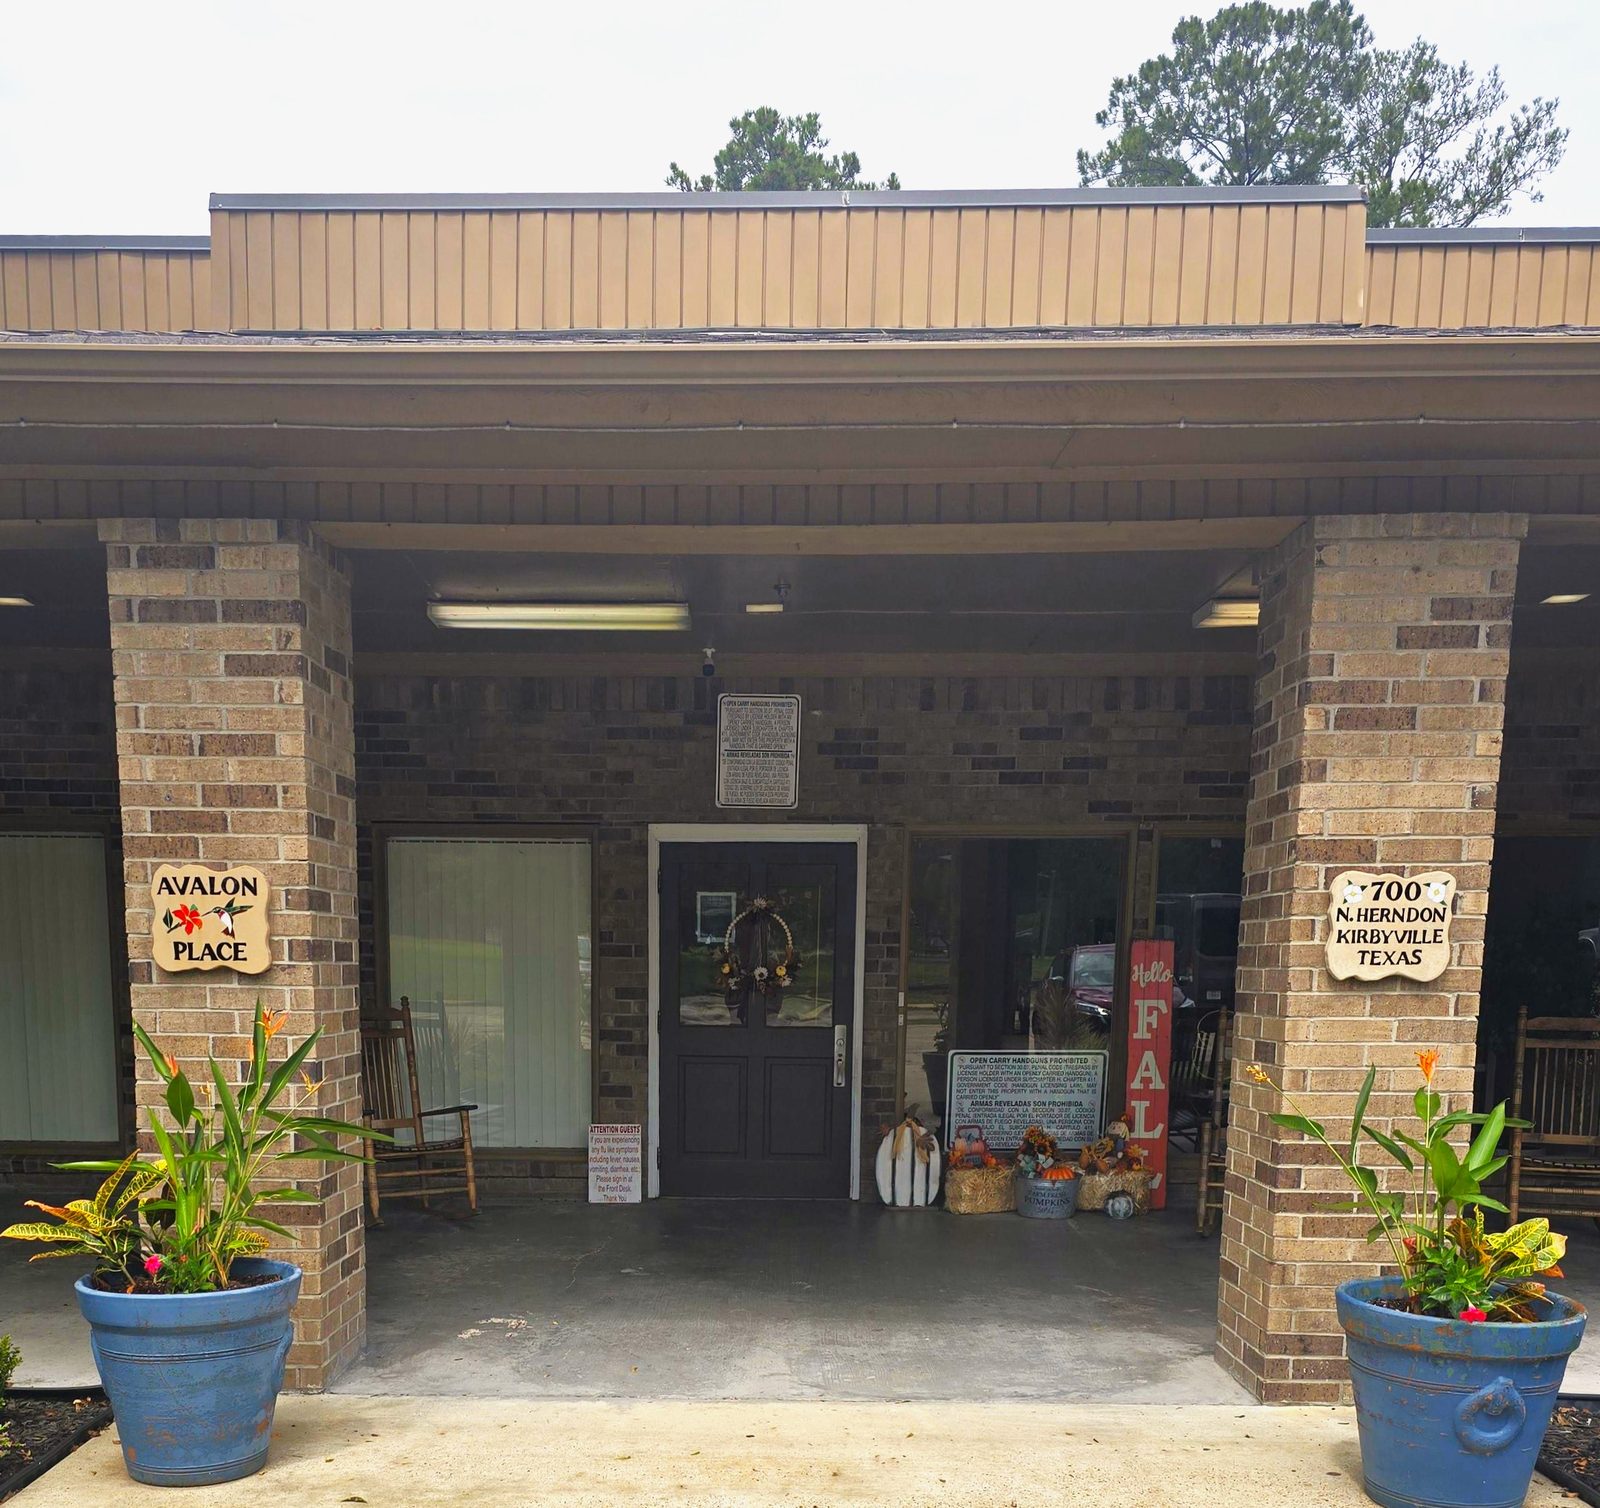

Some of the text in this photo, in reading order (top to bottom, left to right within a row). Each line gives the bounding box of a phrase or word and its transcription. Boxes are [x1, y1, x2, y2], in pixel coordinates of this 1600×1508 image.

[157, 876, 258, 896] AVALON
[1371, 881, 1421, 901] 700
[1336, 907, 1447, 922] N. HERNDON
[1336, 929, 1444, 944] KIRBYVILLE
[173, 941, 248, 961] PLACE
[1357, 949, 1422, 965] TEXAS
[1131, 961, 1172, 987] Hello
[594, 1137, 602, 1145] you
[612, 1137, 640, 1145] experiencing
[591, 1146, 599, 1154] any
[616, 1146, 639, 1154] symptoms
[612, 1175, 621, 1183] sign
[1024, 1195, 1070, 1206] PUMPKINS
